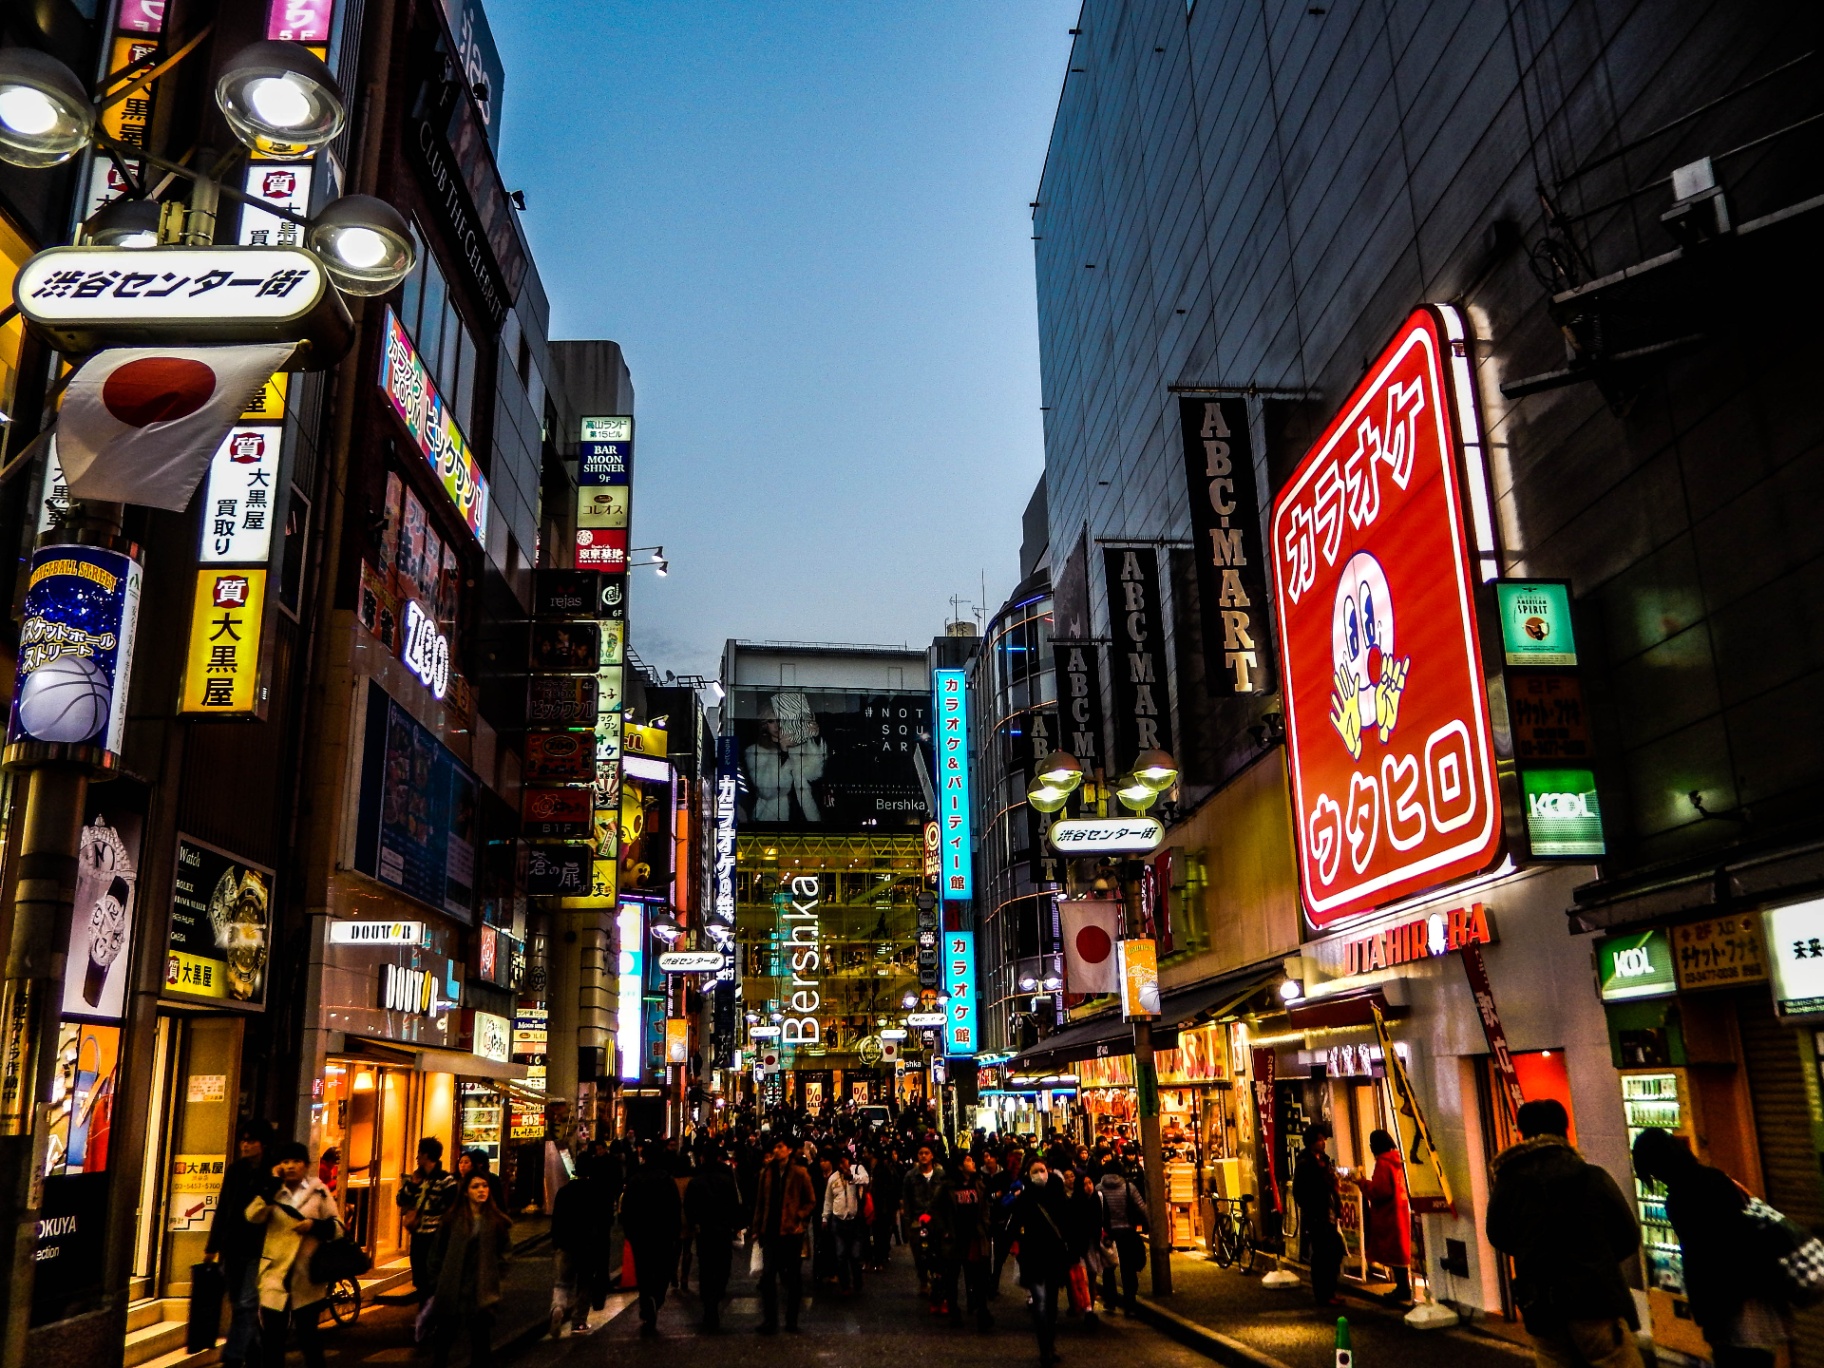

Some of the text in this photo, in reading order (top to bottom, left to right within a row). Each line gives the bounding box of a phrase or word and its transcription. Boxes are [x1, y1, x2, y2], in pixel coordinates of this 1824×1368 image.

[419, 120, 448, 193] CLUB
[31, 269, 311, 299] 渋谷センター街
[387, 330, 424, 402] カラオケ
[391, 373, 422, 434] ROOM
[585, 420, 627, 430] 高山ランド
[234, 437, 262, 462] 質
[587, 455, 623, 464] MOON
[593, 445, 617, 455] BAR
[583, 464, 625, 473] SHINER
[599, 474, 611, 483] 9F
[242, 468, 271, 530] 大黒屋
[1285, 376, 1426, 605] カラオケ
[583, 504, 623, 515] コレオス
[214, 499, 238, 556] 買取り
[1200, 402, 1258, 693] ABC-MART
[79, 561, 118, 593] STREET
[217, 579, 246, 605] 質
[549, 594, 583, 608] rejas
[1517, 605, 1548, 614] SPIRIT
[22, 642, 94, 675] ストリート
[200, 613, 243, 708] 大黒屋
[1121, 551, 1161, 757] ABC-MAR
[944, 678, 967, 891] カラオケ&パーティー館
[876, 798, 926, 811] Bershka
[1310, 718, 1477, 887] ウタヒロ
[1057, 827, 1158, 842] 渋谷センター街
[179, 846, 201, 868] Watch
[529, 850, 582, 888] 蒼の扉
[350, 923, 411, 940] DOUTOR
[182, 961, 212, 988] 大黒屋
[661, 956, 722, 966] 渋谷センター街
[781, 875, 821, 1044] Bershka
[385, 963, 439, 1018] DOUTOR
[952, 938, 971, 1043] カラオケ館
[187, 1161, 224, 1174] 大黒屋
